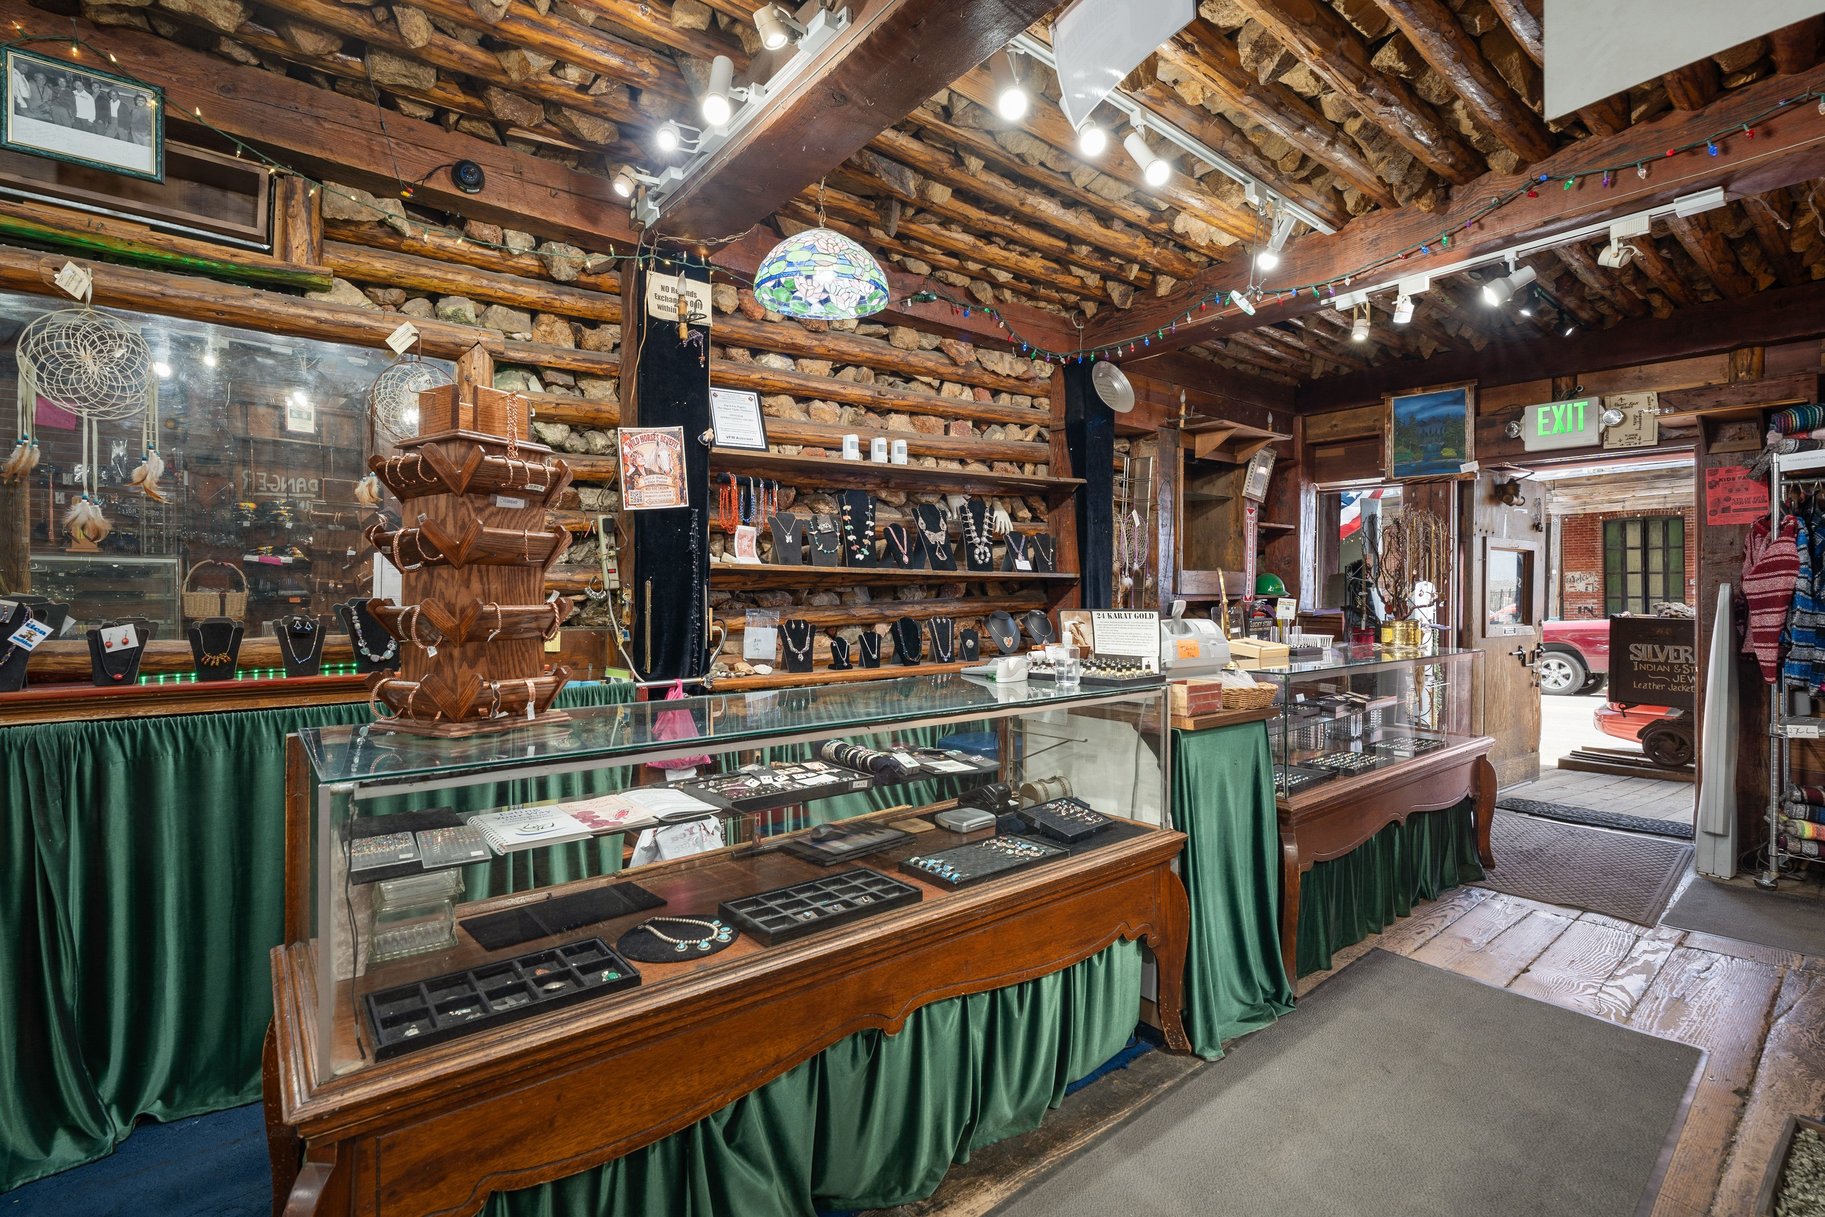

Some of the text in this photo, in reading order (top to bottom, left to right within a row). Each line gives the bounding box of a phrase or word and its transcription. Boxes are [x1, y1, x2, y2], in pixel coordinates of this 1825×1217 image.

[660, 284, 697, 299] NO Rends
[1537, 401, 1588, 437] EXIT
[624, 436, 640, 450] WILD
[1134, 612, 1154, 620] GOLD
[1629, 643, 1696, 663] SILVER
[1633, 661, 1671, 672] INDIAN
[1633, 681, 1666, 690] Leather
